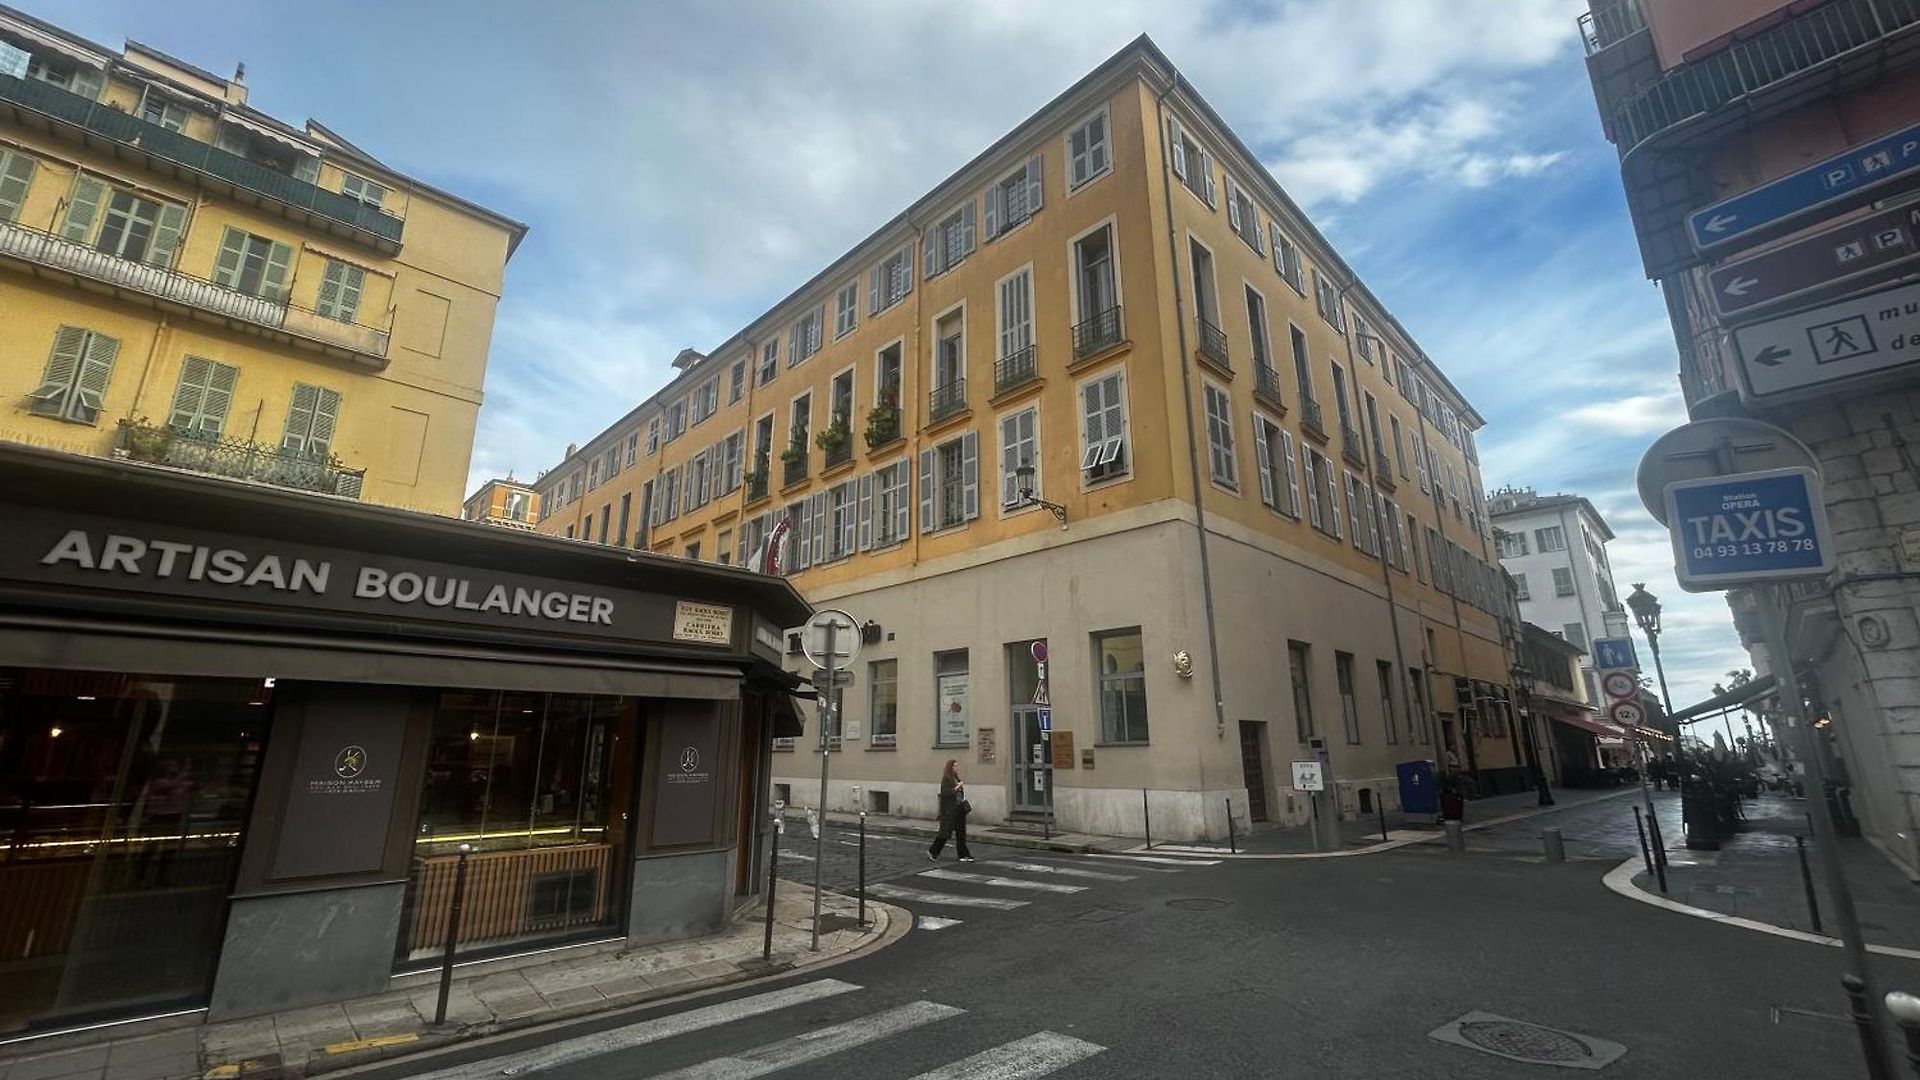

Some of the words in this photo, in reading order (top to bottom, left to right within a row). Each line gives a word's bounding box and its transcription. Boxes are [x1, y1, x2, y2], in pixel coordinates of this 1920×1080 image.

[1828, 170, 1846, 186] P
[1879, 232, 1897, 246] P
[1879, 302, 1918, 321] mu
[1722, 493, 1757, 501] Station
[1688, 507, 1805, 544] TAXIS
[1694, 547, 1713, 559] 04
[1717, 545, 1738, 557] 93
[1742, 543, 1762, 556] 13
[1767, 541, 1788, 554] 78
[1792, 538, 1814, 551] 78
[40, 530, 331, 594] ARTISAN
[354, 567, 615, 625] BOULANGER
